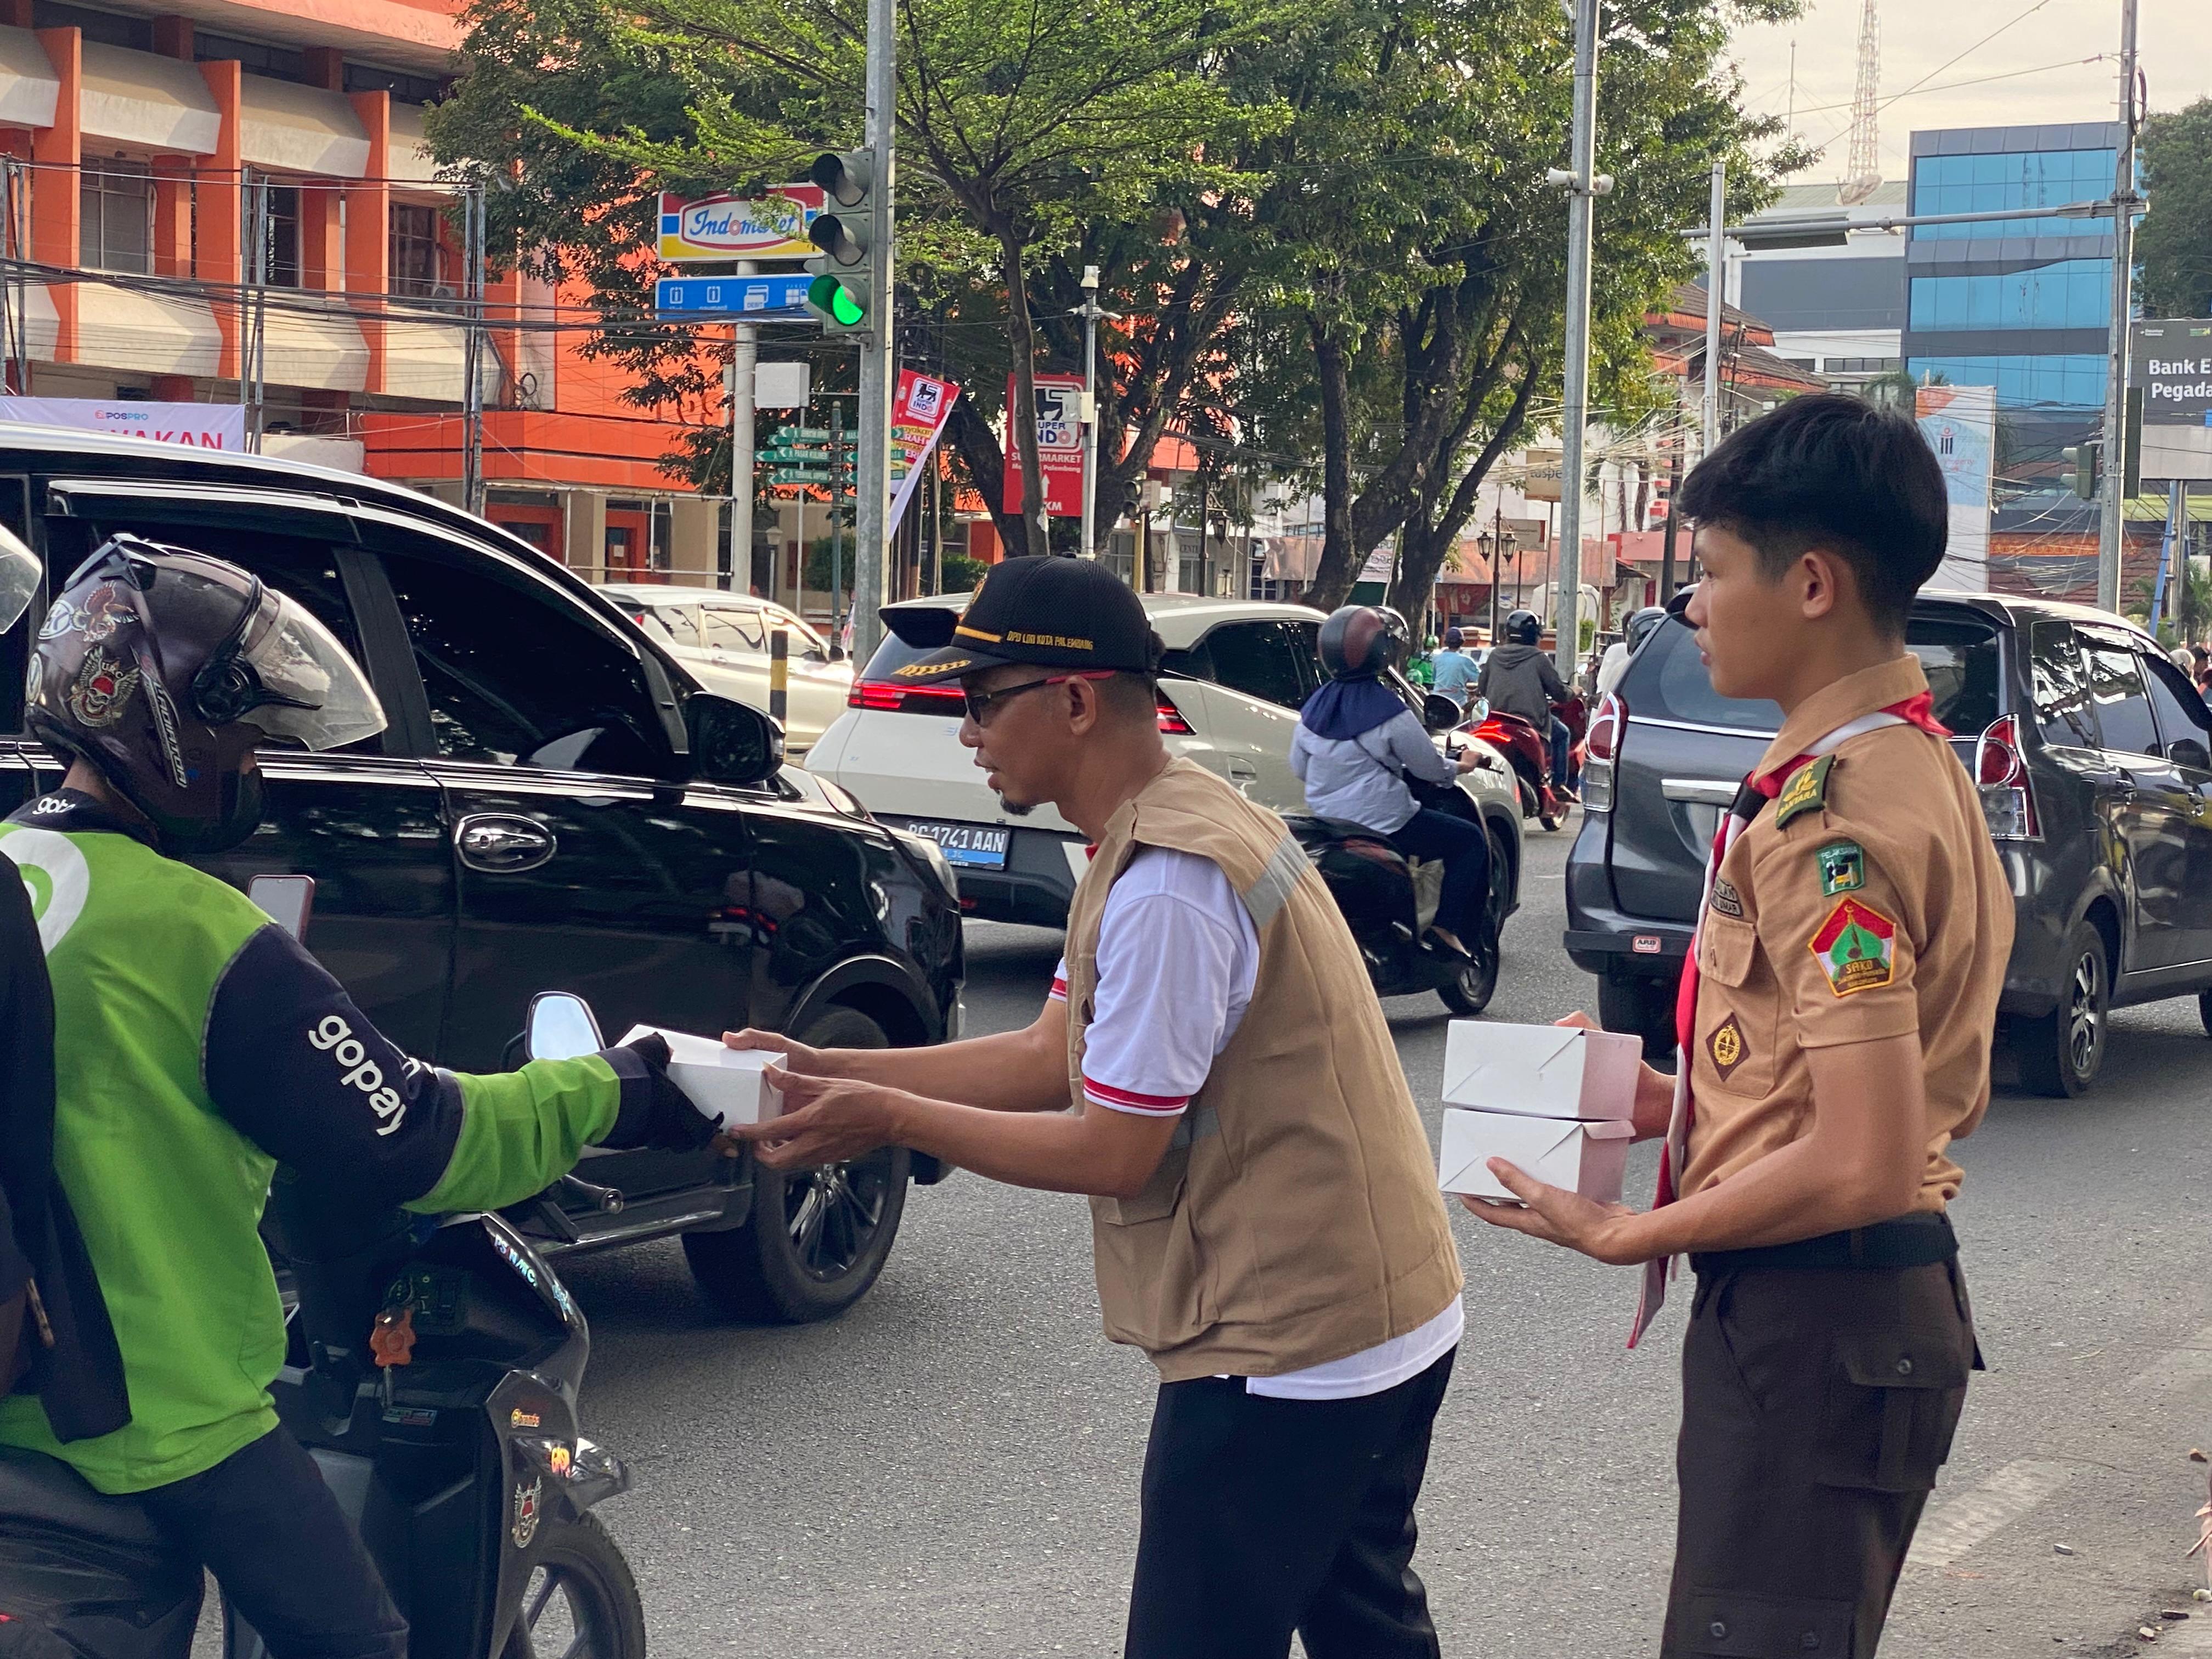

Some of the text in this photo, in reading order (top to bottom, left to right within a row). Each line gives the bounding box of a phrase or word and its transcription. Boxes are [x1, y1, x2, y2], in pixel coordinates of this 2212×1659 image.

[2148, 359, 2196, 375] Bank
[1037, 421, 1065, 430] UPER
[1006, 631, 1022, 642] DPD
[1036, 635, 1053, 646] KOTA
[931, 826, 969, 849] 1741
[971, 831, 1006, 853] AAN
[1845, 960, 1873, 974] SAKO
[308, 1015, 407, 1136] gopay
